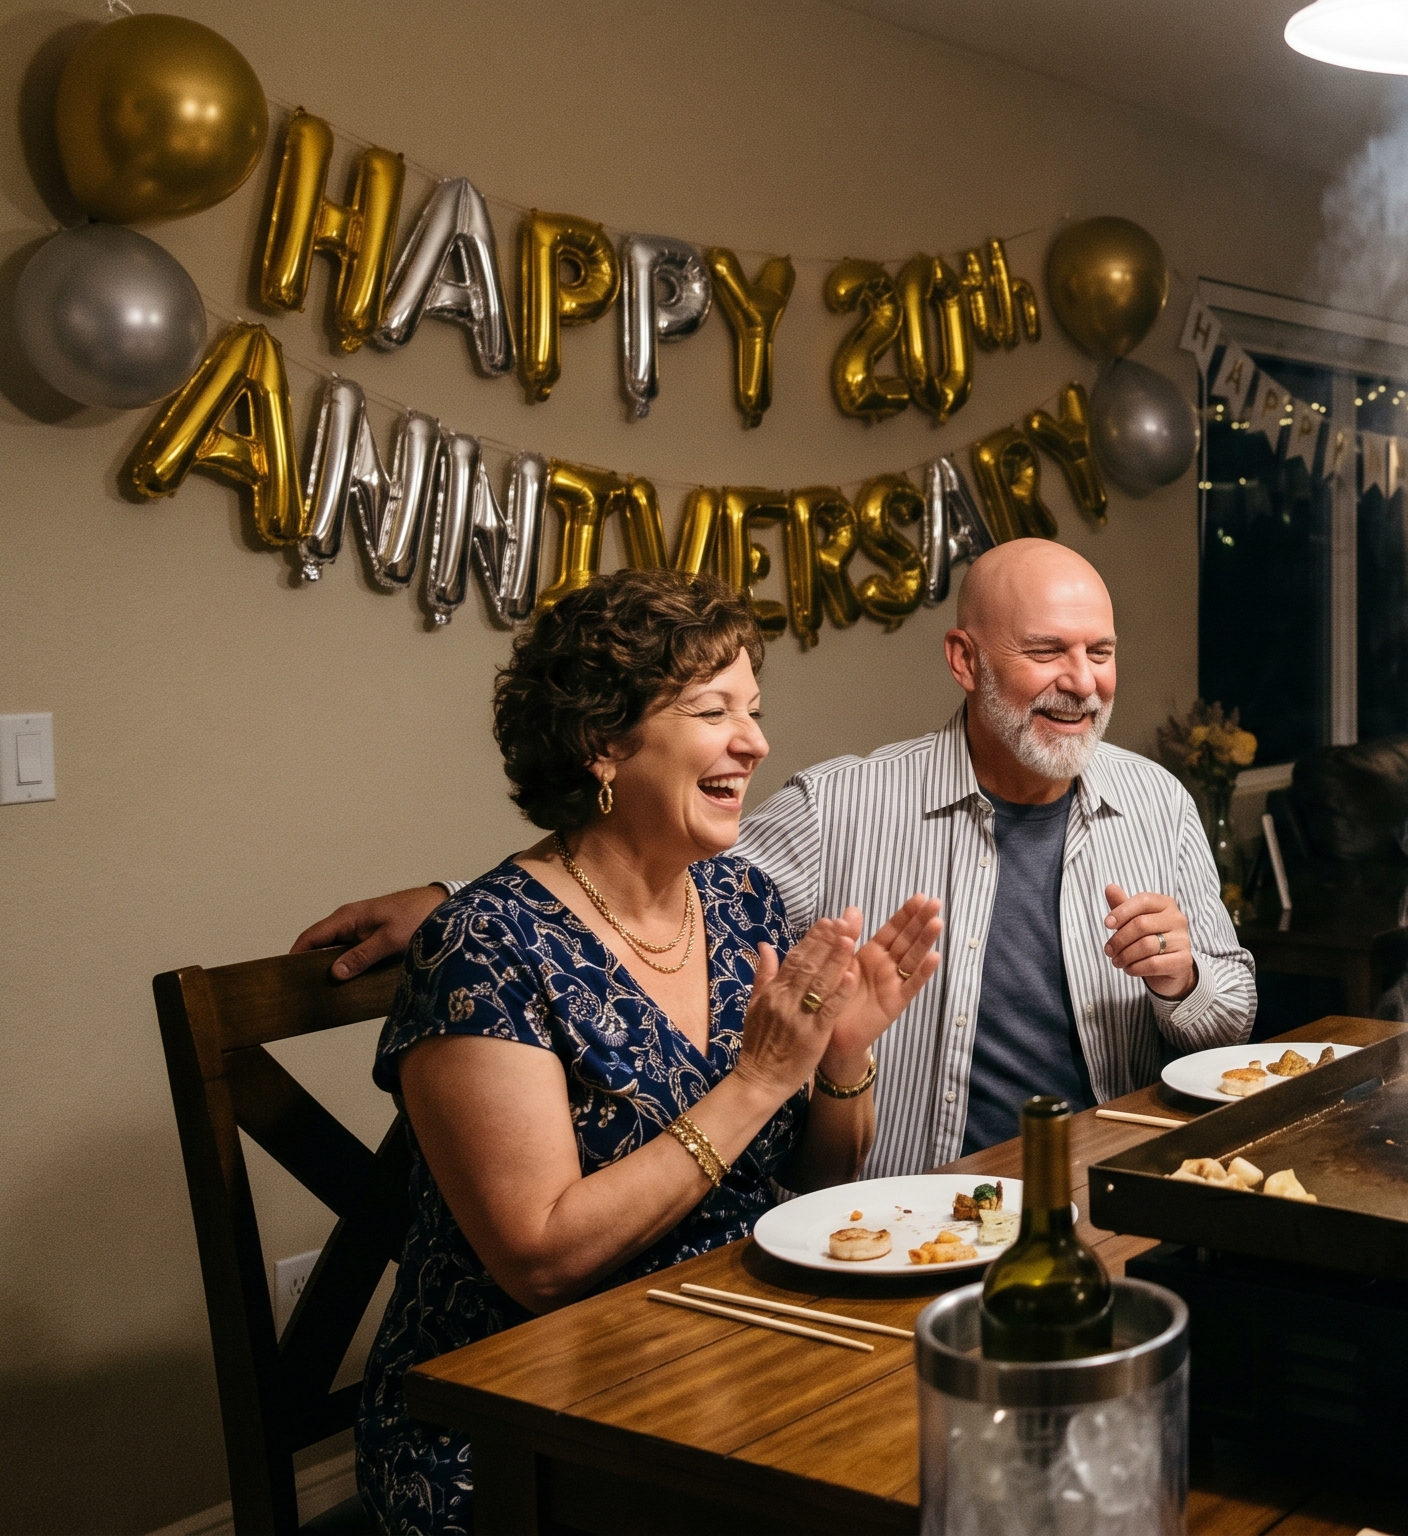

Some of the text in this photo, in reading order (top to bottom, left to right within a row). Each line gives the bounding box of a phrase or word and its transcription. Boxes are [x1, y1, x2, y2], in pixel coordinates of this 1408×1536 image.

[260, 108, 1042, 427] HAPPY 20th
[128, 320, 1108, 650] ANNIVERSARY
